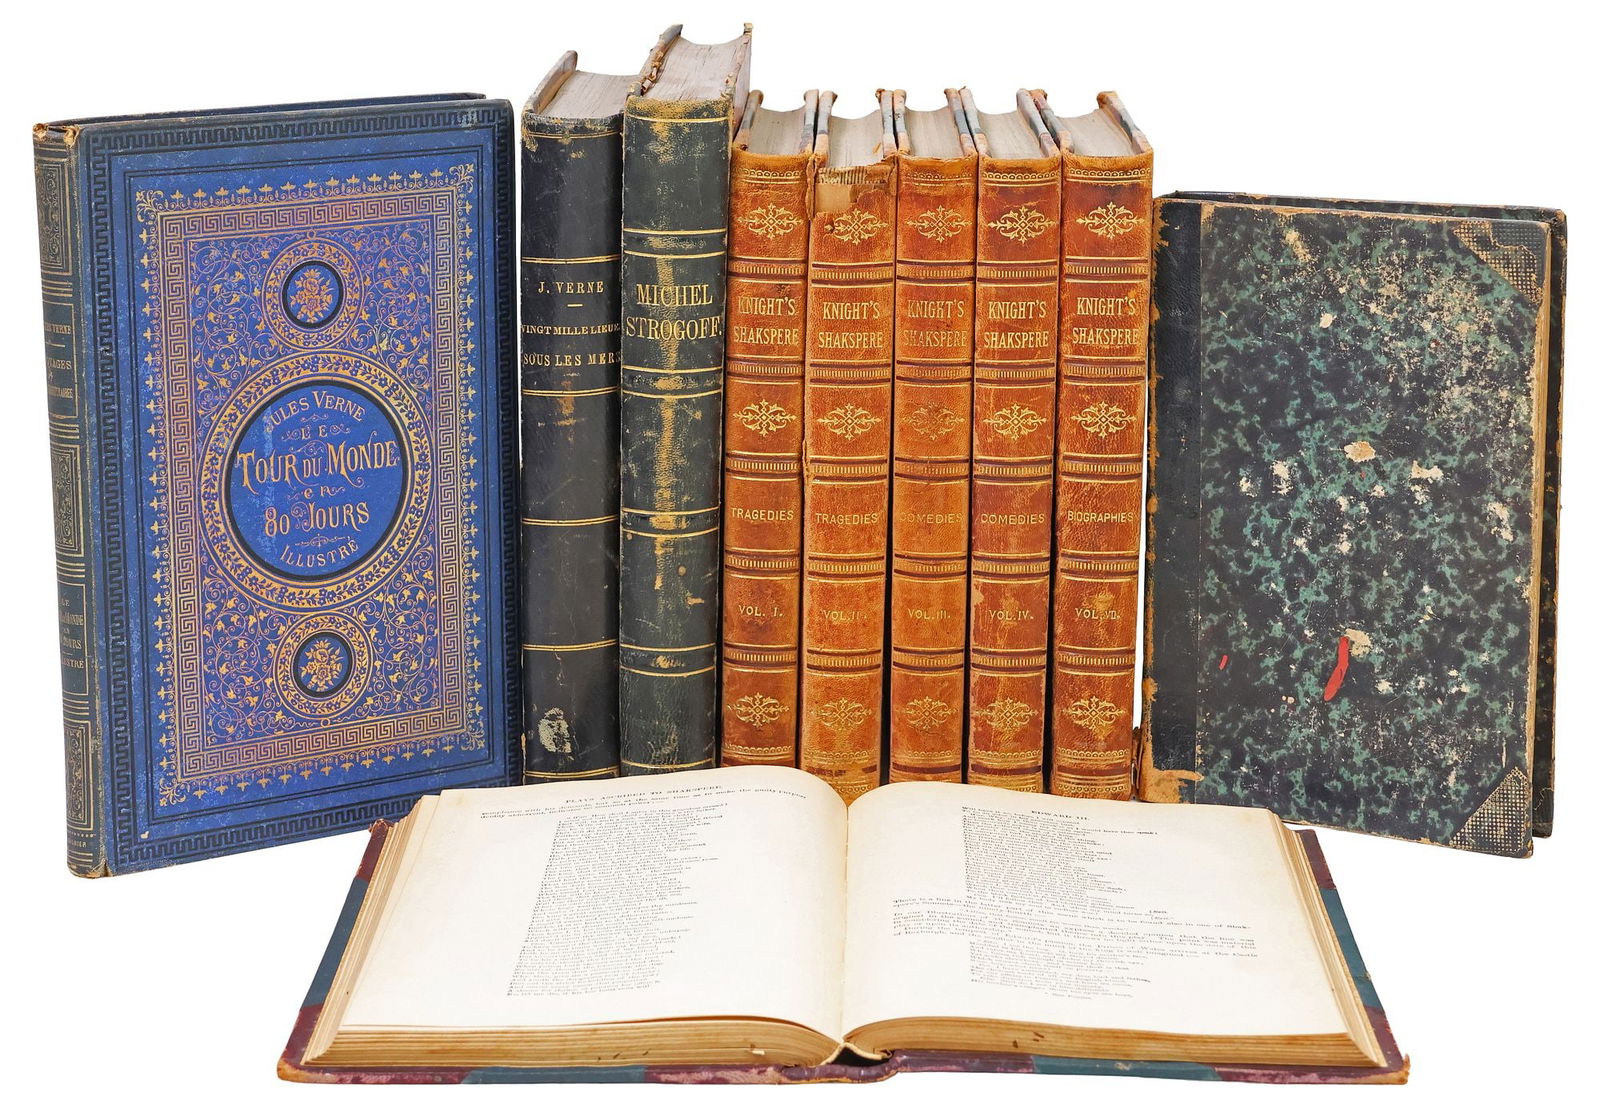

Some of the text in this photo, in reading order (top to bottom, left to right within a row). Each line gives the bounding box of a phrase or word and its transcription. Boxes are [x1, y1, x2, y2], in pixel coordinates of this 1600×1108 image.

[538, 281, 604, 294] J. VERNE
[636, 283, 714, 307] MICHEL
[738, 296, 796, 316] KNIGHT'S
[823, 301, 880, 320] KNIGHT'S
[907, 300, 965, 319] KNIGHT'S
[988, 300, 1047, 319] KNIGHT'S
[1076, 296, 1136, 316] KNIGHT'S
[521, 324, 552, 335] VINGT
[553, 326, 589, 335] MILLE
[626, 316, 723, 340] STROGOFF.
[734, 326, 799, 345] SHAKSPERE
[1072, 327, 1139, 345] SHAKSPERE
[818, 331, 884, 349] SHAKSPERE
[903, 330, 968, 348] SHAKSPERE
[984, 330, 1049, 349] SHAKSPERE
[523, 352, 551, 367] SOUS
[555, 354, 581, 367] LES
[312, 390, 366, 422] VERNE
[236, 434, 400, 494] TOUR DU MONDE
[265, 502, 370, 537] 80 JOURS
[732, 508, 794, 521] TRAGEDIES
[815, 512, 879, 526] TRAGEDIES
[899, 512, 964, 525] COMEDIES
[980, 513, 1045, 526] COMEDIES
[1067, 510, 1134, 523] BIOGRAPHIES
[738, 605, 766, 617] VOL.
